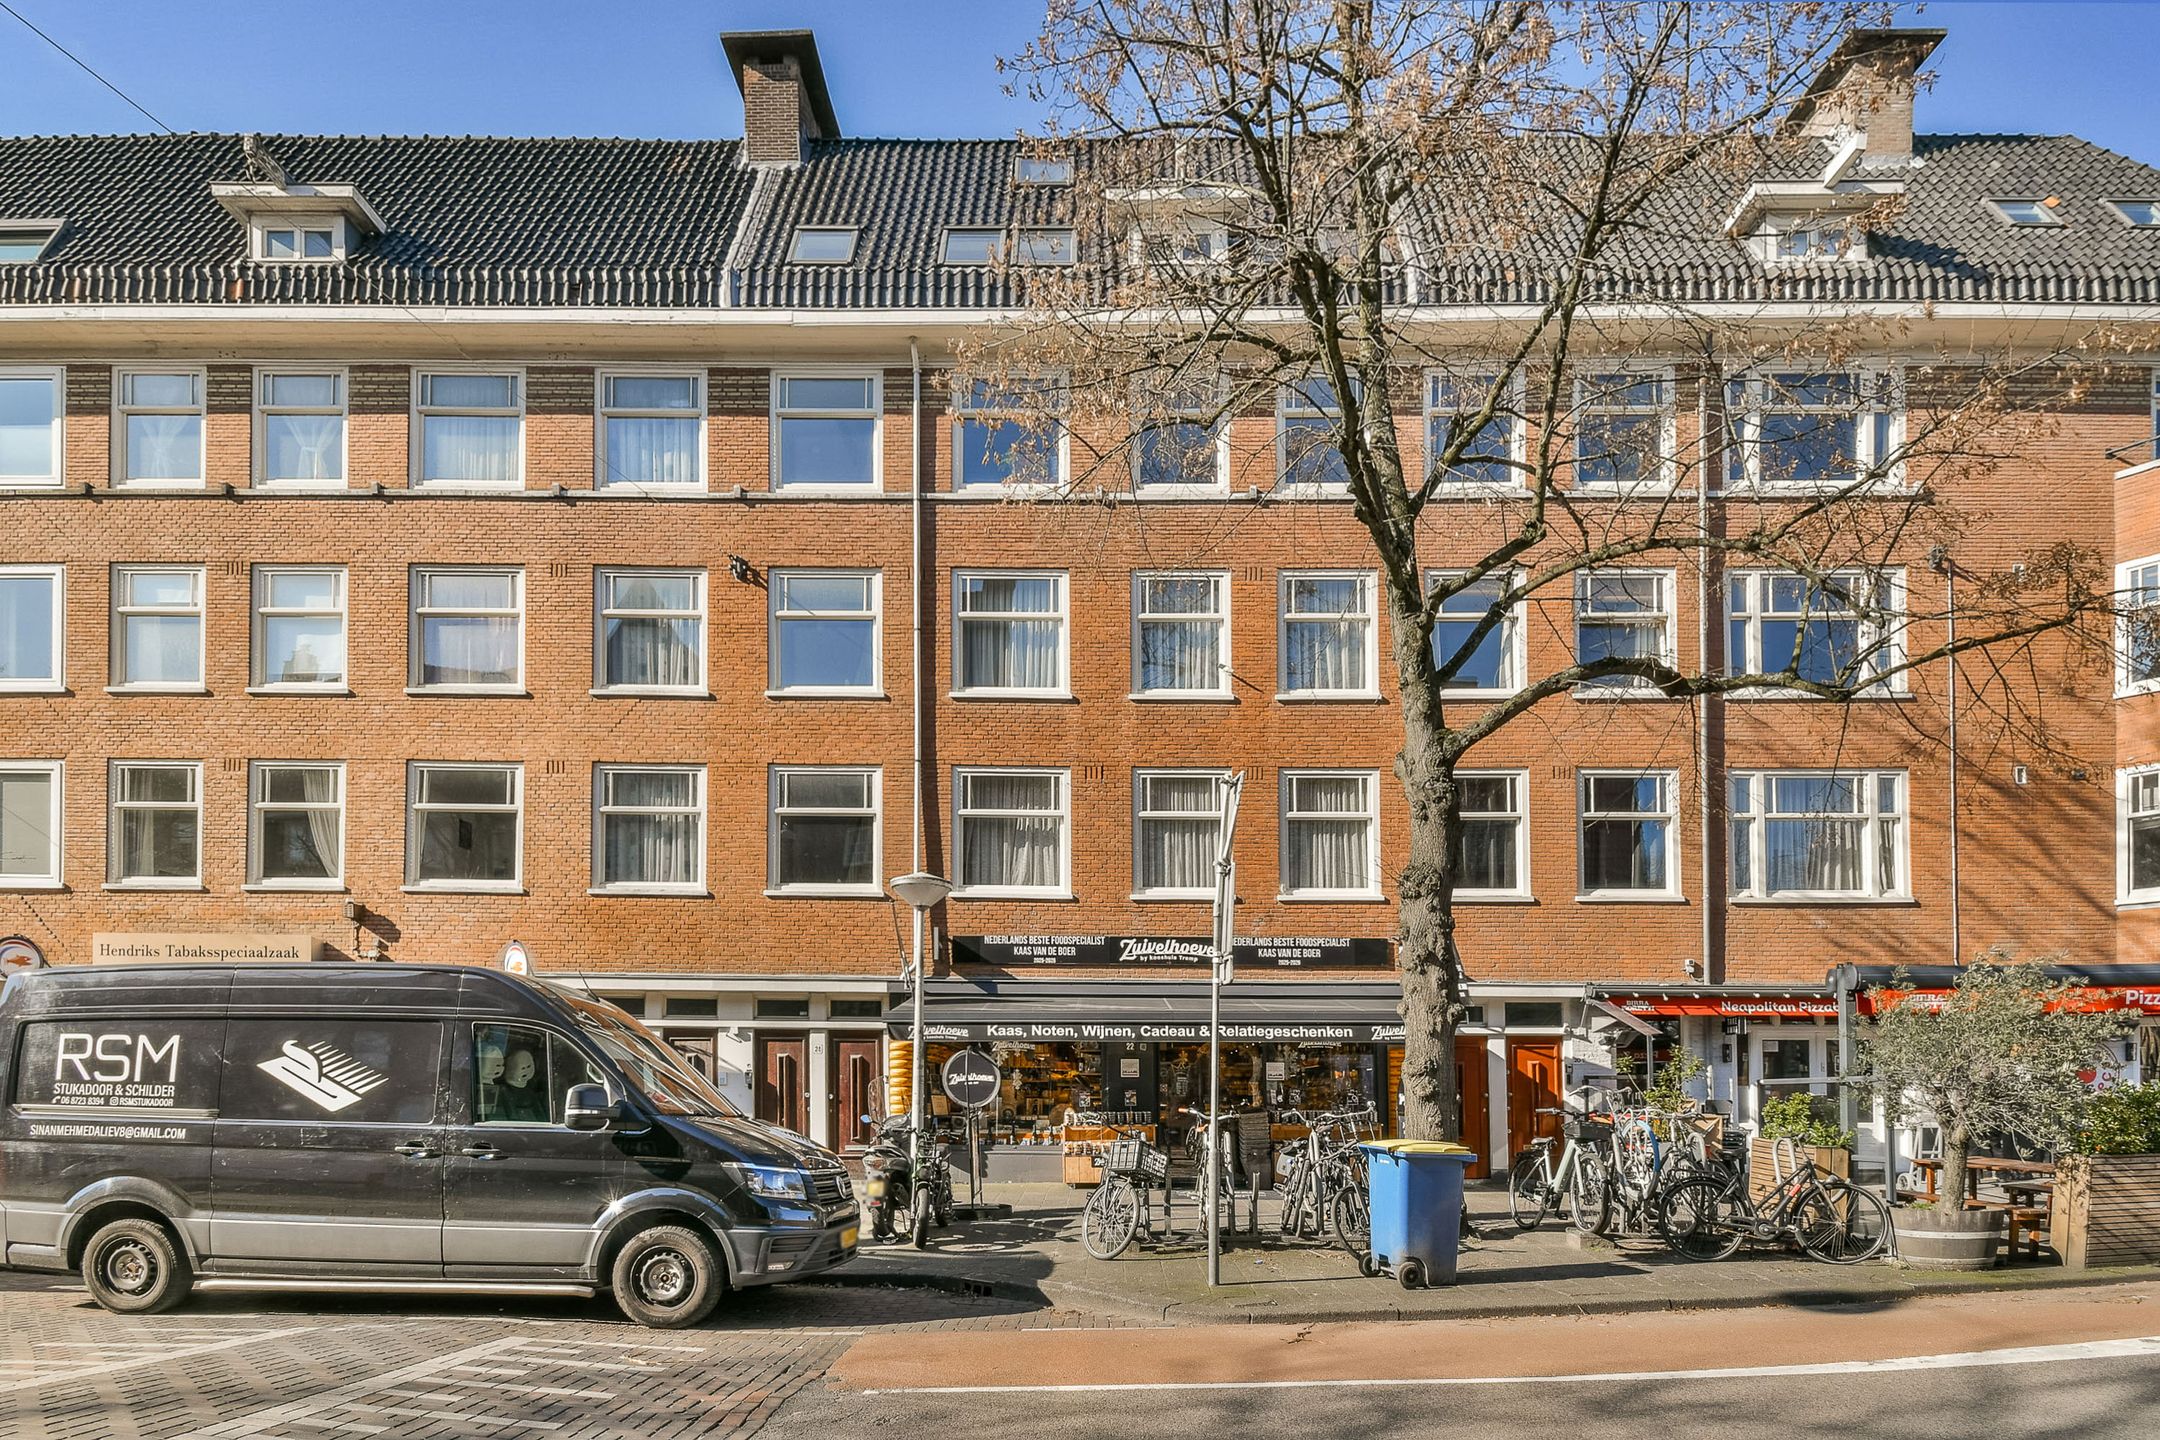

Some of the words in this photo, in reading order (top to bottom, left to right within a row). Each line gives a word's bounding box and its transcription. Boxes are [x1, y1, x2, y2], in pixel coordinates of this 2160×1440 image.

[984, 935, 1028, 945] NEDERLANDS
[1029, 935, 1050, 945] BESTE
[1051, 936, 1106, 945] FOODSPECIALIST
[1232, 937, 1273, 947] EDERLANDS
[1273, 937, 1295, 947] BESTE
[1295, 938, 1351, 947] FOODSPECIALIST
[100, 943, 160, 957] Hendriks
[165, 944, 299, 961] Tabaksspeciaalzaak
[1013, 946, 1032, 956] KAAS
[1033, 946, 1047, 956] VAN
[1048, 947, 1057, 956] DE
[1058, 947, 1076, 956] BOER
[1119, 938, 1217, 962] Zuivelhoeve
[1258, 948, 1277, 958] KAAS
[1277, 948, 1292, 958] VAN
[1292, 948, 1302, 958] DE
[1302, 948, 1321, 958] BOER
[2125, 989, 2160, 1006] Pizz
[1721, 1001, 1796, 1014] Neapolitan
[907, 1025, 969, 1040] Zivelhoeve
[986, 1025, 1027, 1038] Kaas,
[1031, 1025, 1078, 1038] Noten,
[1081, 1025, 1136, 1039] Wijnen,
[1140, 1025, 1195, 1037] Cadeau
[1199, 1025, 1211, 1037] &
[1217, 1025, 1353, 1039] Relatiegeschenken
[1371, 1025, 1407, 1040] Zuivel
[1126, 1042, 1135, 1050] 22
[55, 1033, 180, 1082] RSM
[53, 1083, 113, 1096] STUKADOOR
[115, 1085, 124, 1096] &
[125, 1084, 175, 1097] SCHILDER
[60, 1097, 70, 1105] 06
[71, 1097, 86, 1105] 8723
[119, 1098, 174, 1107] RSMSTUKADOOR
[30, 1124, 186, 1140] SINANMEHMEDALIEV8@GMAIL.COM
